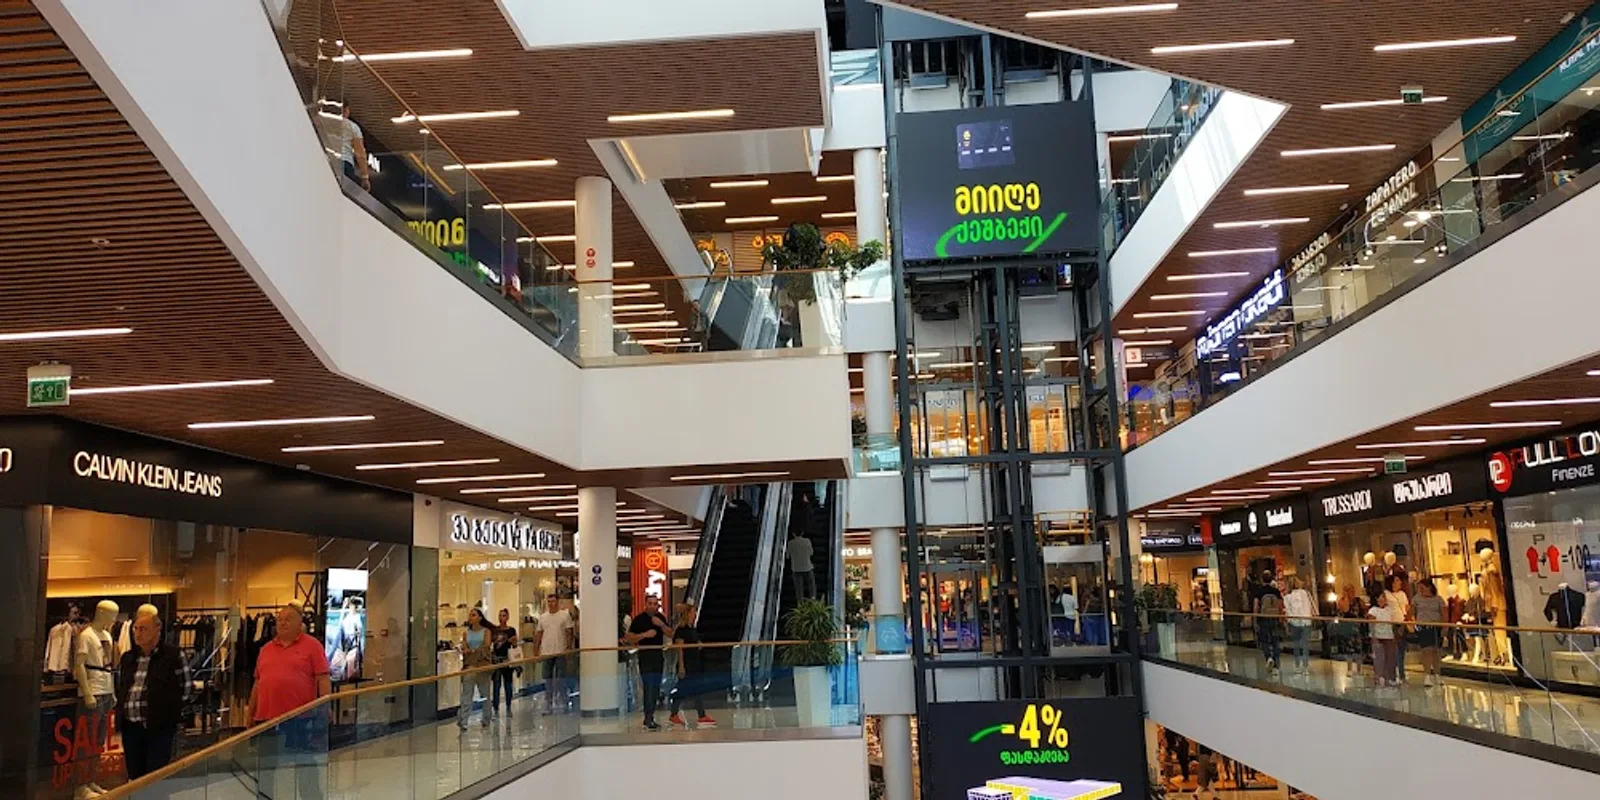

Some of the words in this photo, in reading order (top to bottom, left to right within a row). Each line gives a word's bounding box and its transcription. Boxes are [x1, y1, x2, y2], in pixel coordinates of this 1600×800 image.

[955, 182, 1040, 215] მიიღე
[1365, 160, 1416, 213] ZAPATERO
[956, 215, 1043, 244] ქეშბექი
[73, 451, 135, 484] CALVIN
[137, 462, 179, 491] KLEIN
[179, 471, 222, 498] JEANS
[1551, 464, 1595, 482] FIRENZE
[1321, 489, 1372, 517] TRUSSARDI
[1001, 704, 1068, 748] -4%
[1000, 750, 1070, 765] ფასდაკლება
